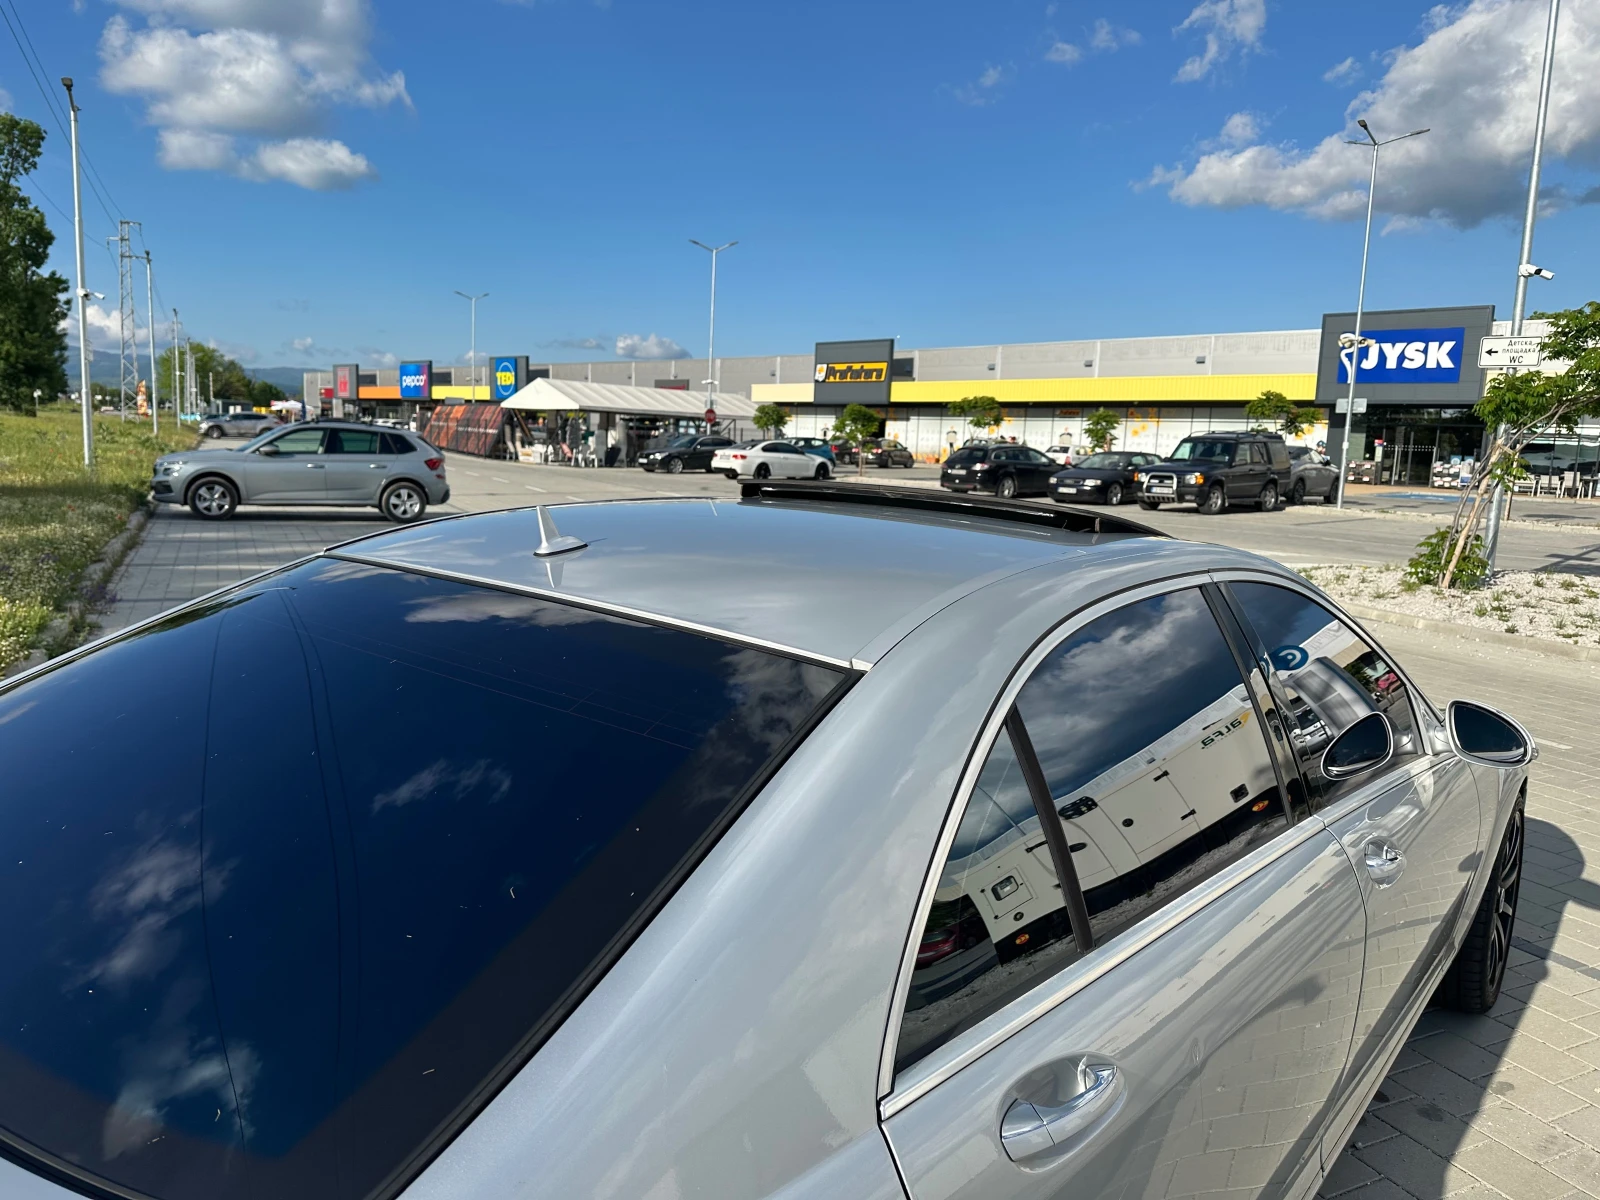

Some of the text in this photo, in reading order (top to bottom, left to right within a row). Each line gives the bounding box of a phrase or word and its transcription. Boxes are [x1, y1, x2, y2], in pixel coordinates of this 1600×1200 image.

[1360, 341, 1456, 370] JYSK
[1509, 355, 1524, 364] WC
[402, 374, 426, 388] pepco
